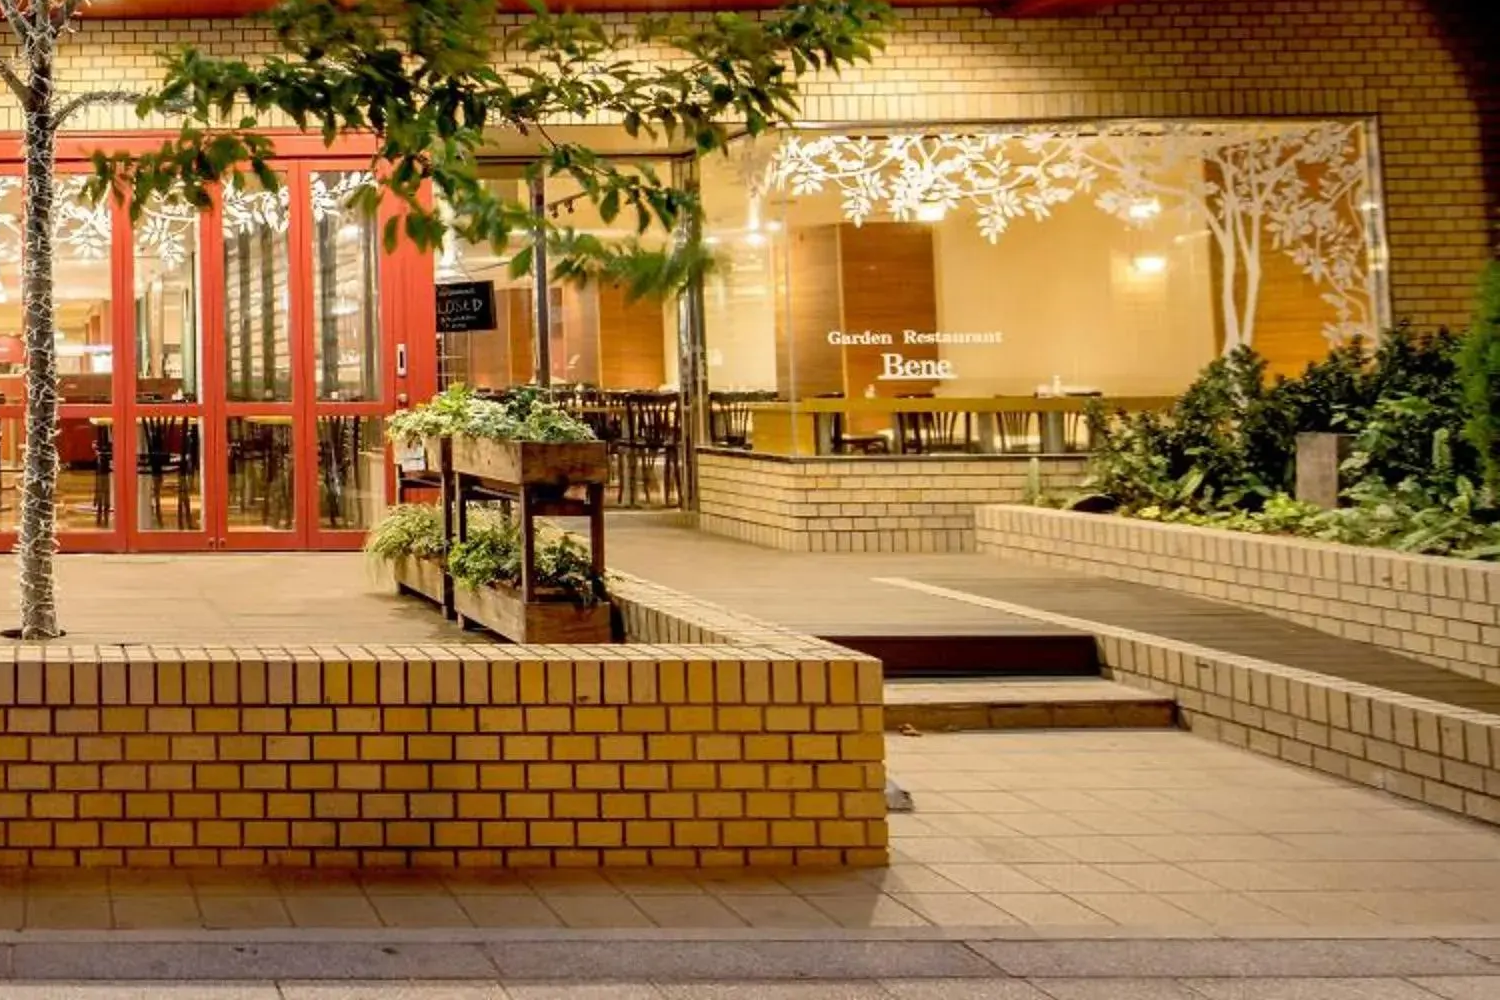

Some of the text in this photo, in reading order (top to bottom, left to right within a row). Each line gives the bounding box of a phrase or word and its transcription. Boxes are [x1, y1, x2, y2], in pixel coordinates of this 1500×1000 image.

[827, 329, 1003, 345] Garden Restaurant
[880, 353, 953, 377] Bene
